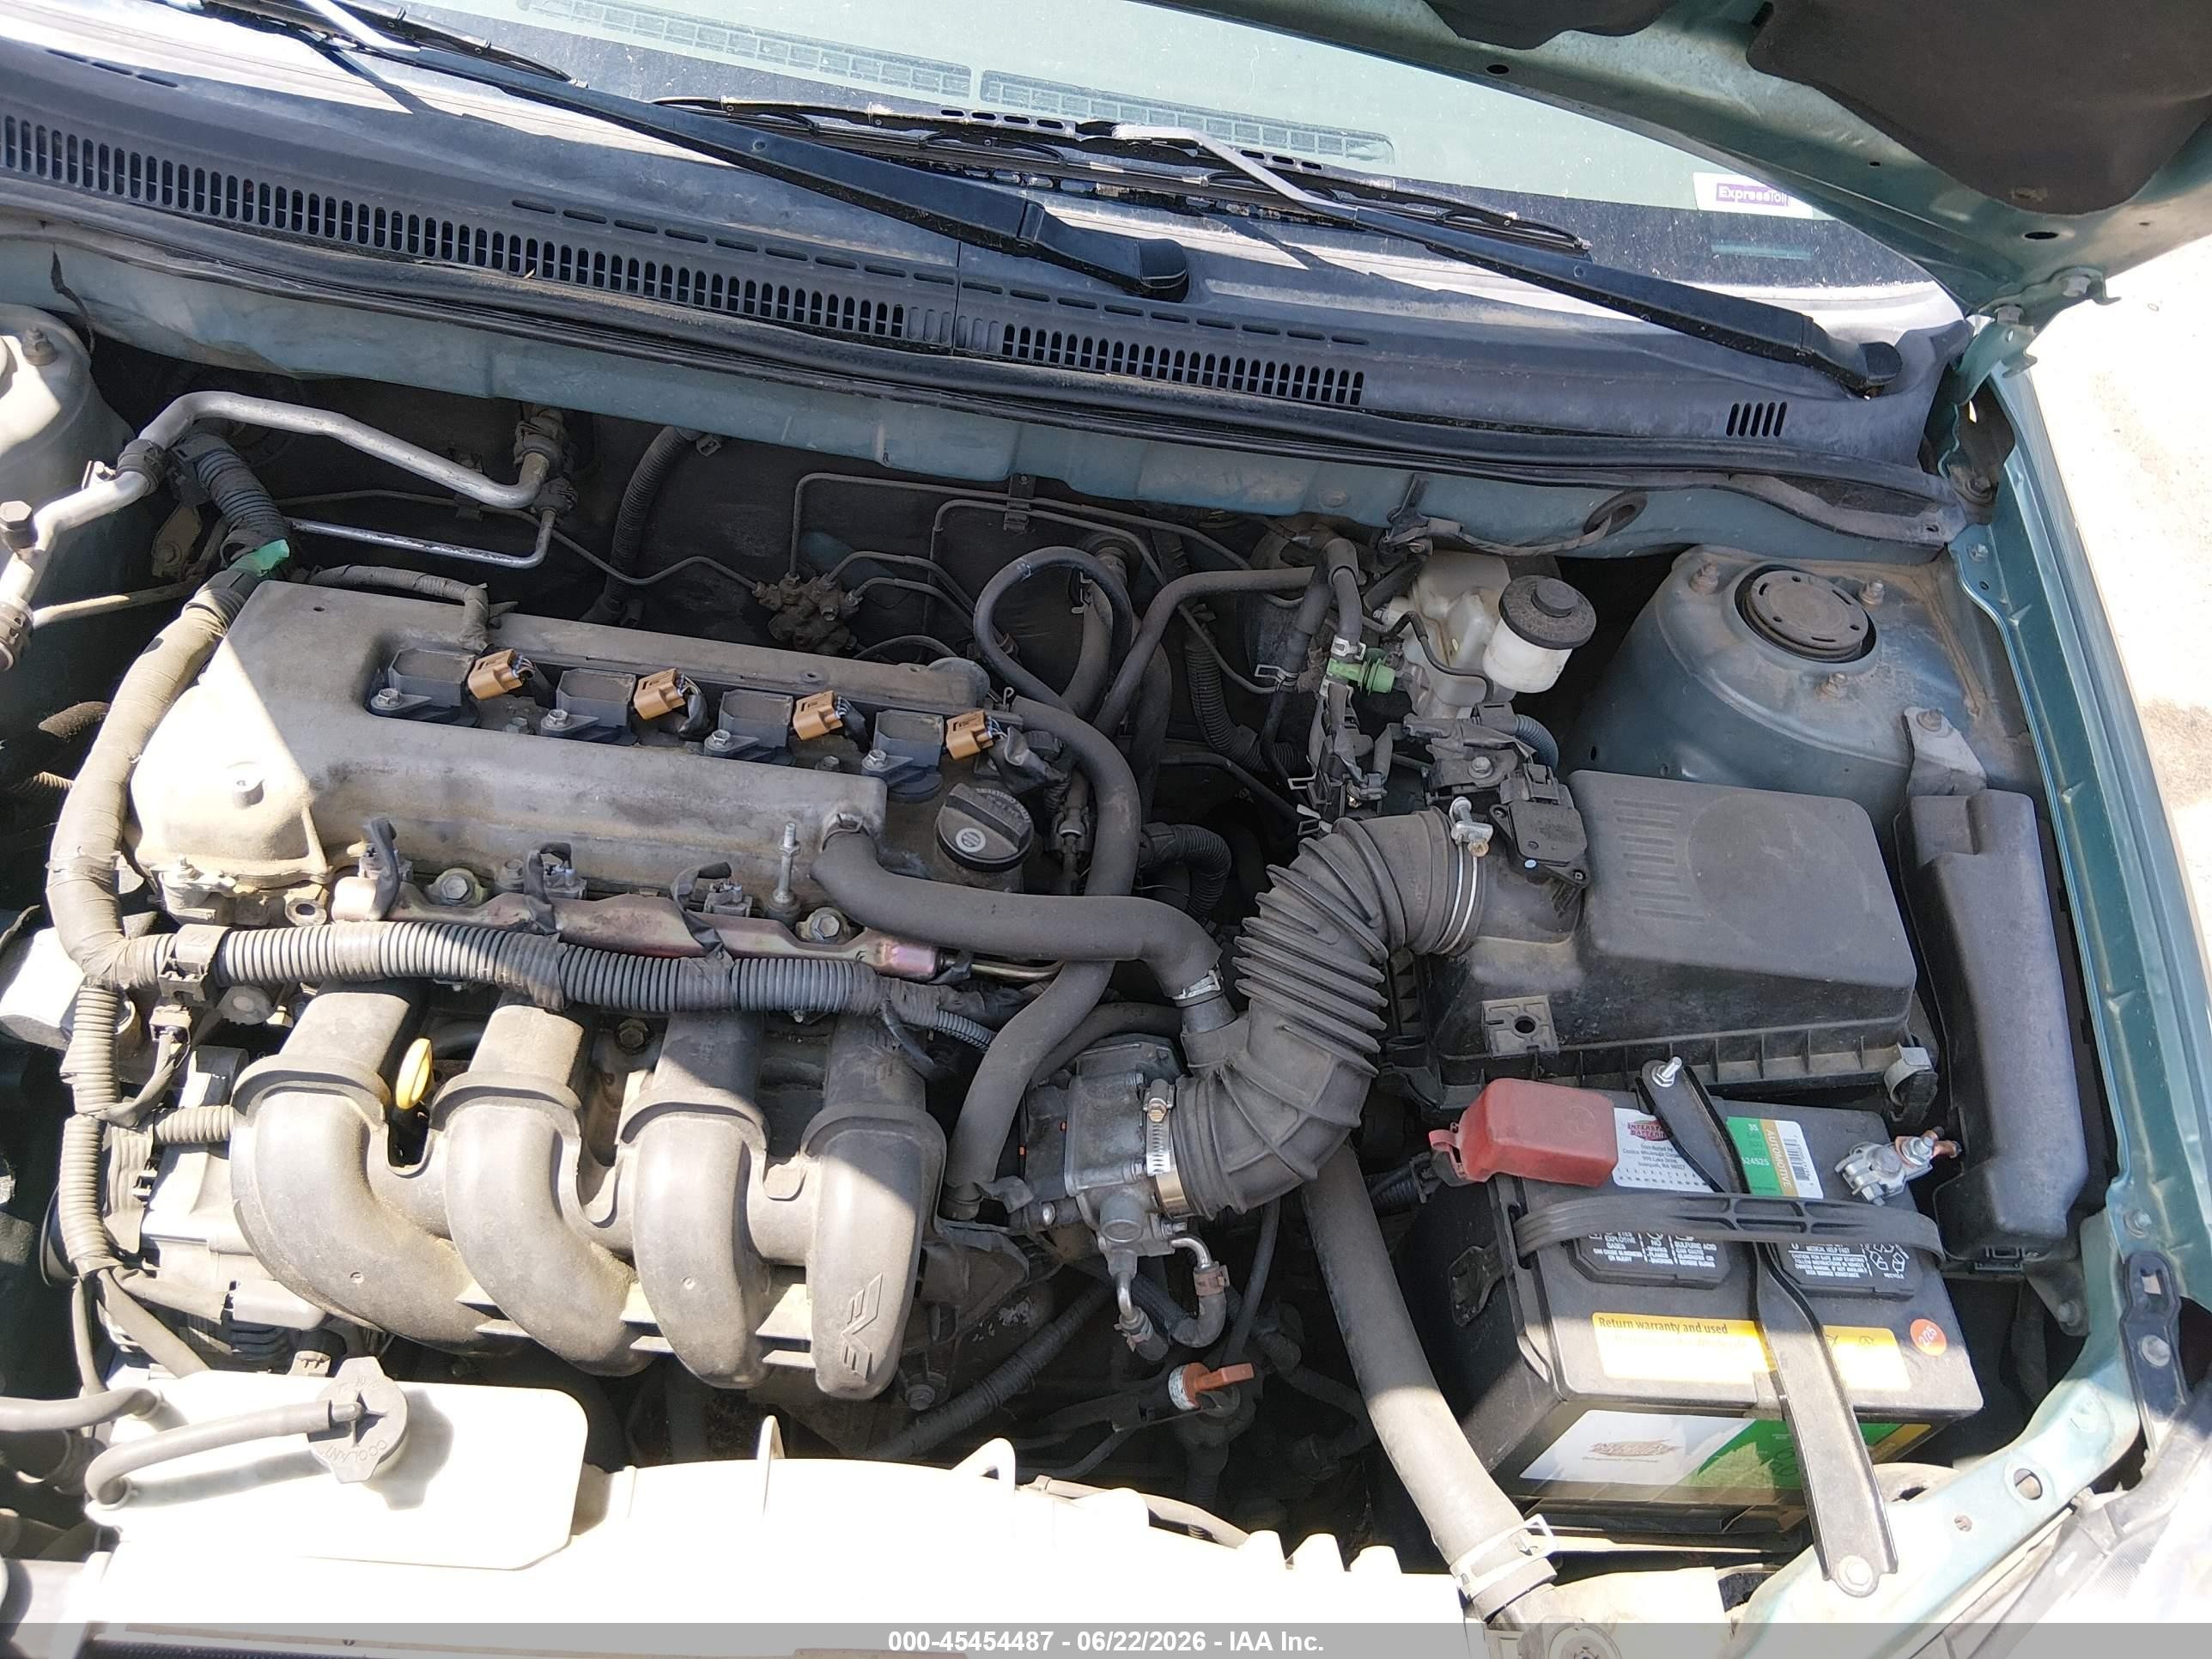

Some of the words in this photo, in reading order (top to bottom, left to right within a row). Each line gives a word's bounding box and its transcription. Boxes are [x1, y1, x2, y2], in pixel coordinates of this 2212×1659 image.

[1766, 1128, 1792, 1189] AUTOMOTIVE
[1598, 1316, 1633, 1329] Return
[1633, 1319, 1680, 1334] warranty
[1682, 1322, 1702, 1334] and
[1704, 1323, 1729, 1334] used
[325, 1439, 388, 1463] COOLANT
